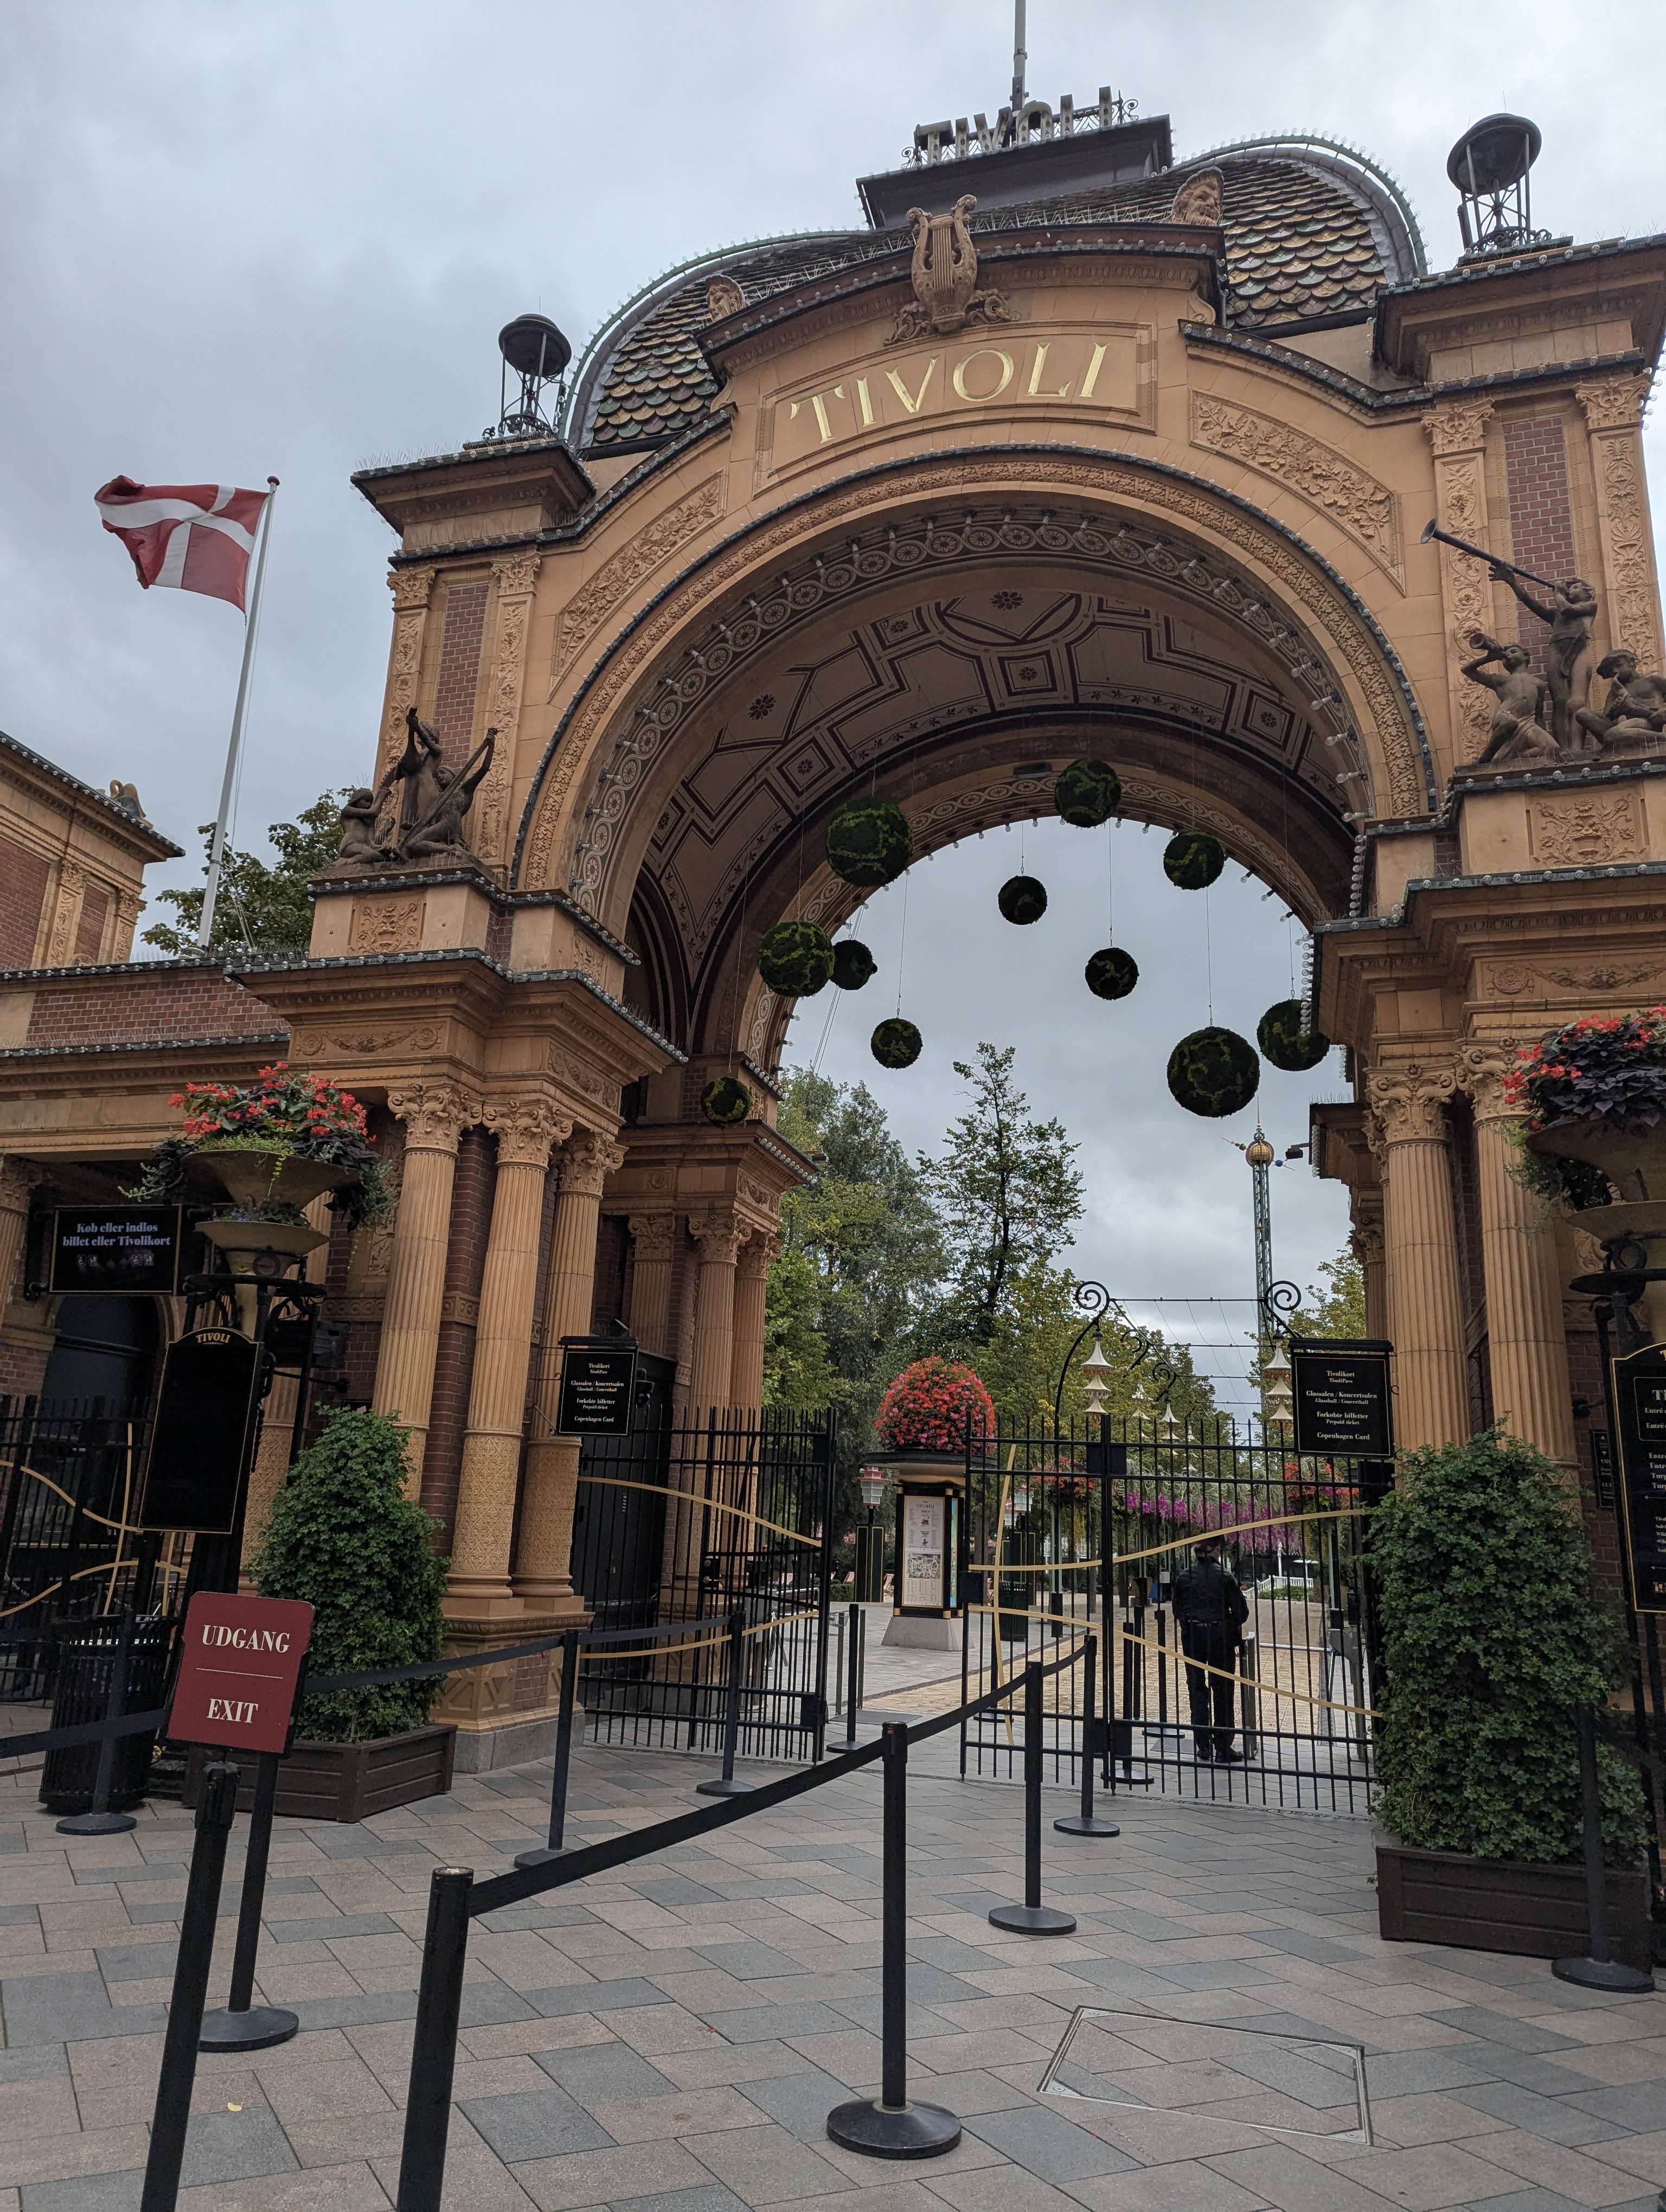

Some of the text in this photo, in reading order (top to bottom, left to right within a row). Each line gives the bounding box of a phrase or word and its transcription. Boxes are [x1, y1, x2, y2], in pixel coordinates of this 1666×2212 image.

[790, 342, 1108, 443] TIVOLI
[99, 1222, 124, 1233] eller
[63, 1236, 171, 1246] billet eller Tivolikort
[196, 1333, 231, 1343] TIVOLI
[1317, 1432, 1353, 1441] Copenhagen
[202, 1625, 290, 1653] UDGANG
[207, 1698, 259, 1724] EXIT
